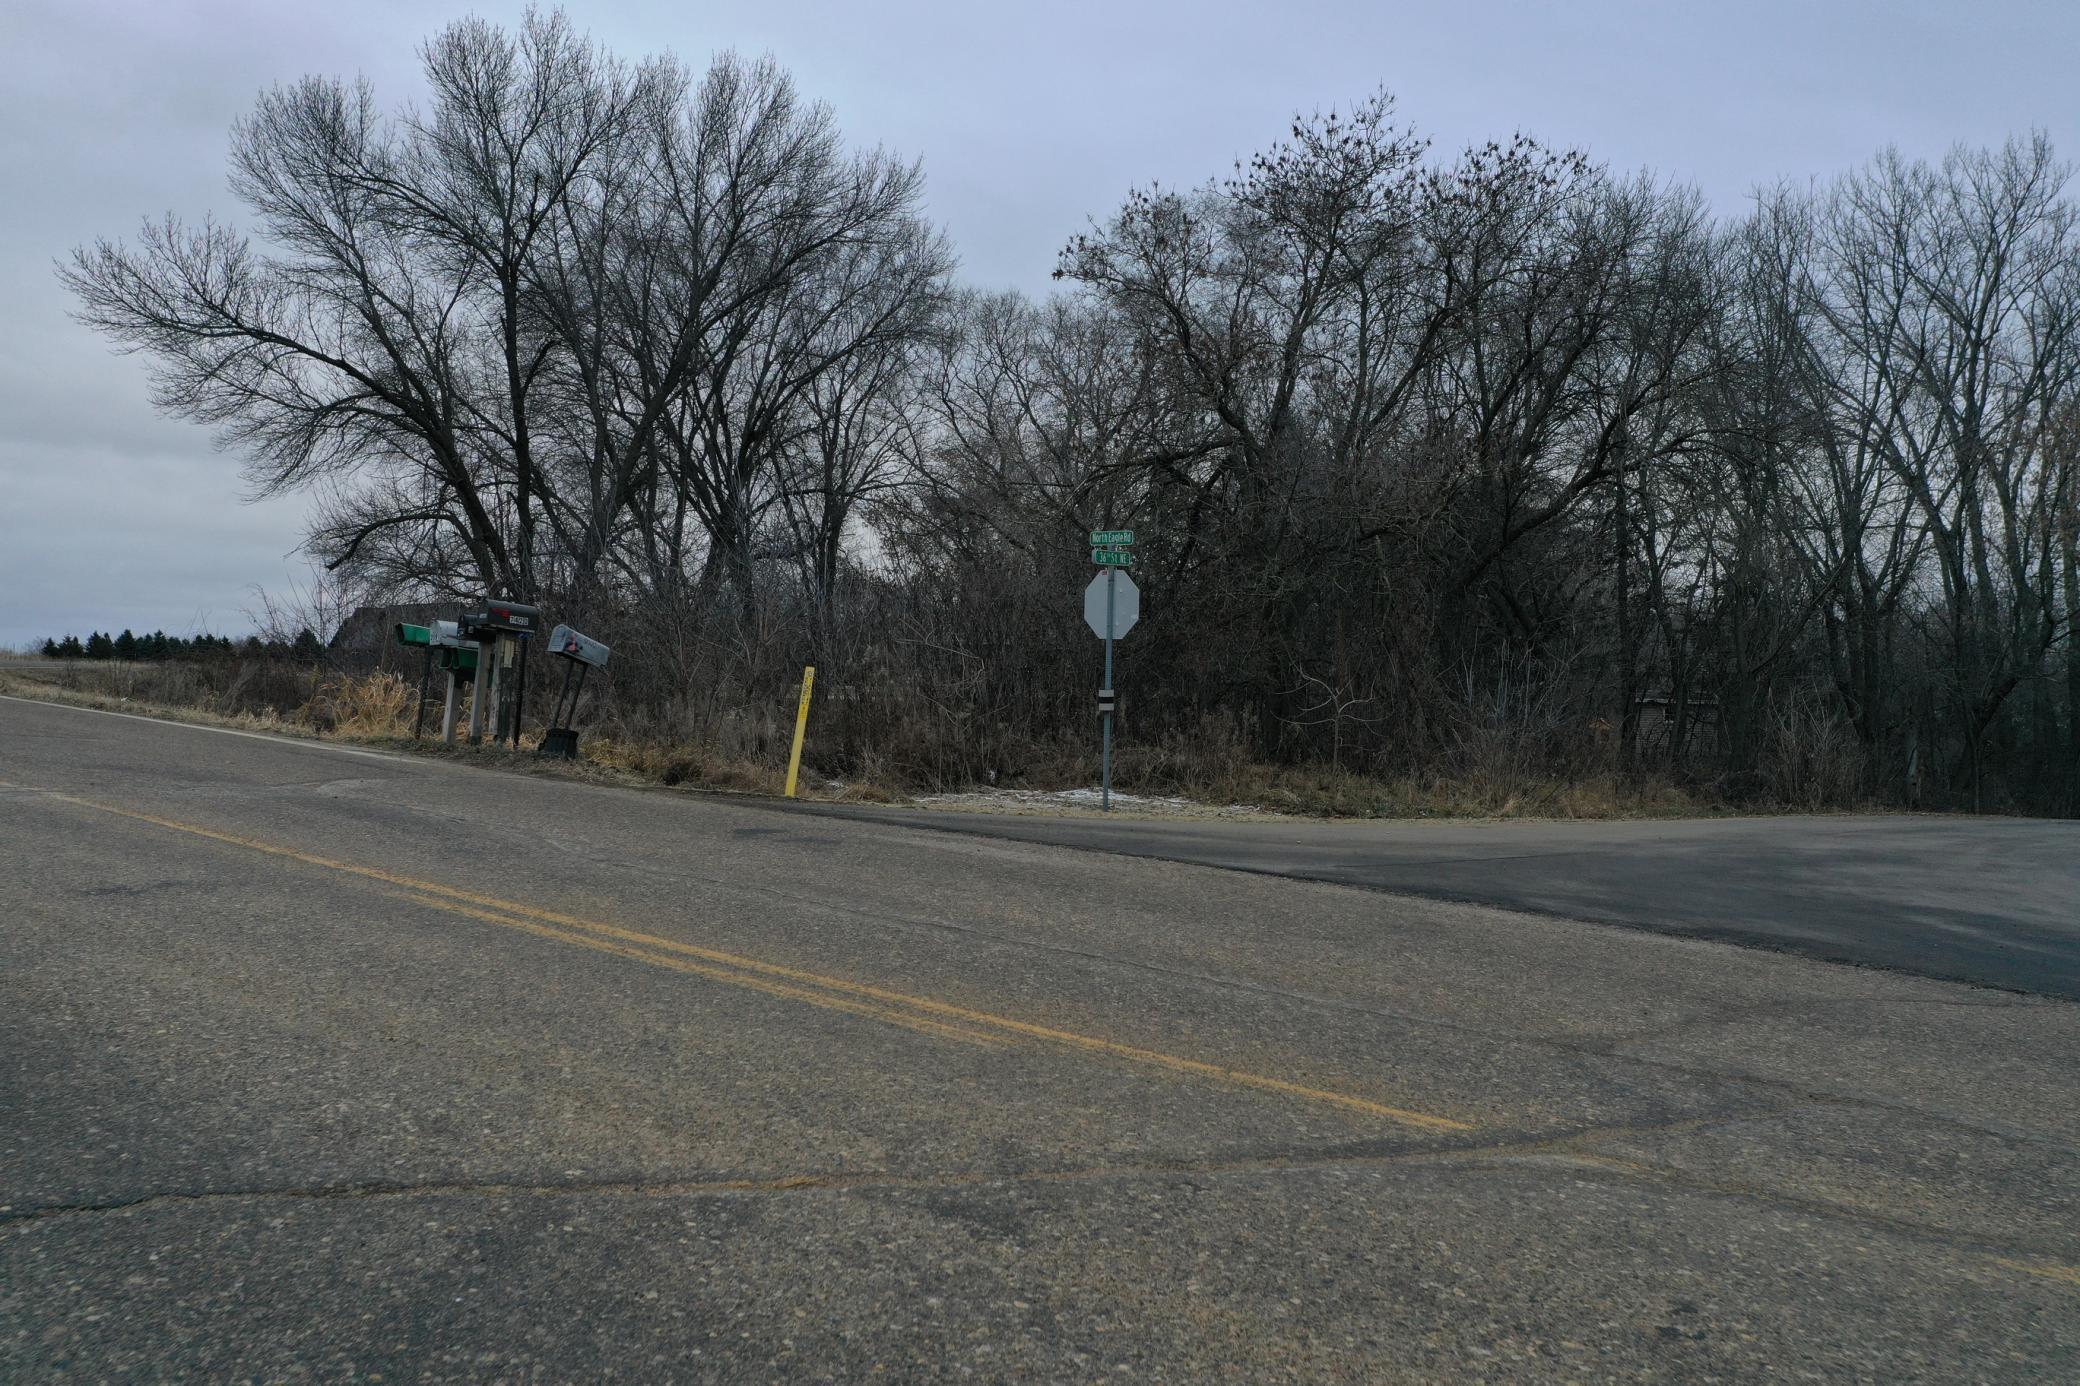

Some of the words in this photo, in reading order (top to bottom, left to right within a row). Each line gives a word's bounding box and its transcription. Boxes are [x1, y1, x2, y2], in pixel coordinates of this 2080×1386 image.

[1092, 532, 1108, 543] North
[1108, 532, 1123, 544] Eagle
[1123, 532, 1132, 543] Rd
[1119, 553, 1127, 564] NE
